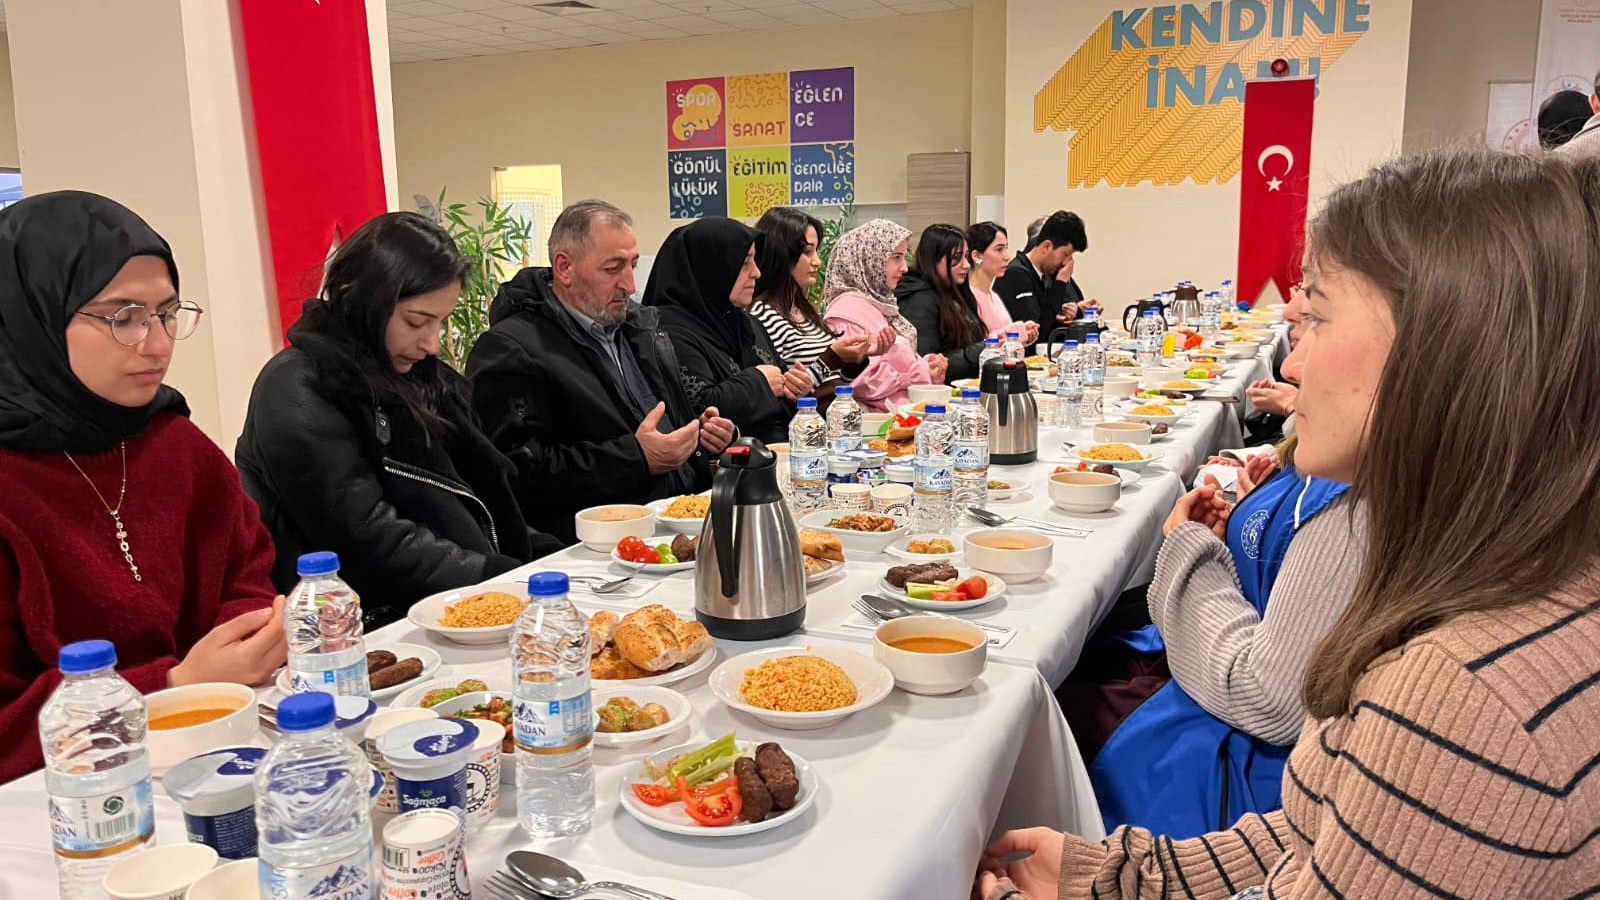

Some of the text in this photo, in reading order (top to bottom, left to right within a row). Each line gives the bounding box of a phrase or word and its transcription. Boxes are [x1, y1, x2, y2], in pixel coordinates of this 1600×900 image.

[676, 92, 717, 108] SPOR
[794, 85, 843, 104] EĞLEN
[794, 112, 815, 127] CE
[732, 121, 786, 137] SANAT
[673, 156, 721, 175] GÖNÜL
[733, 158, 787, 176] EĞİTİM
[674, 178, 718, 196] LÜLÜK
[794, 178, 823, 193] DAİR
